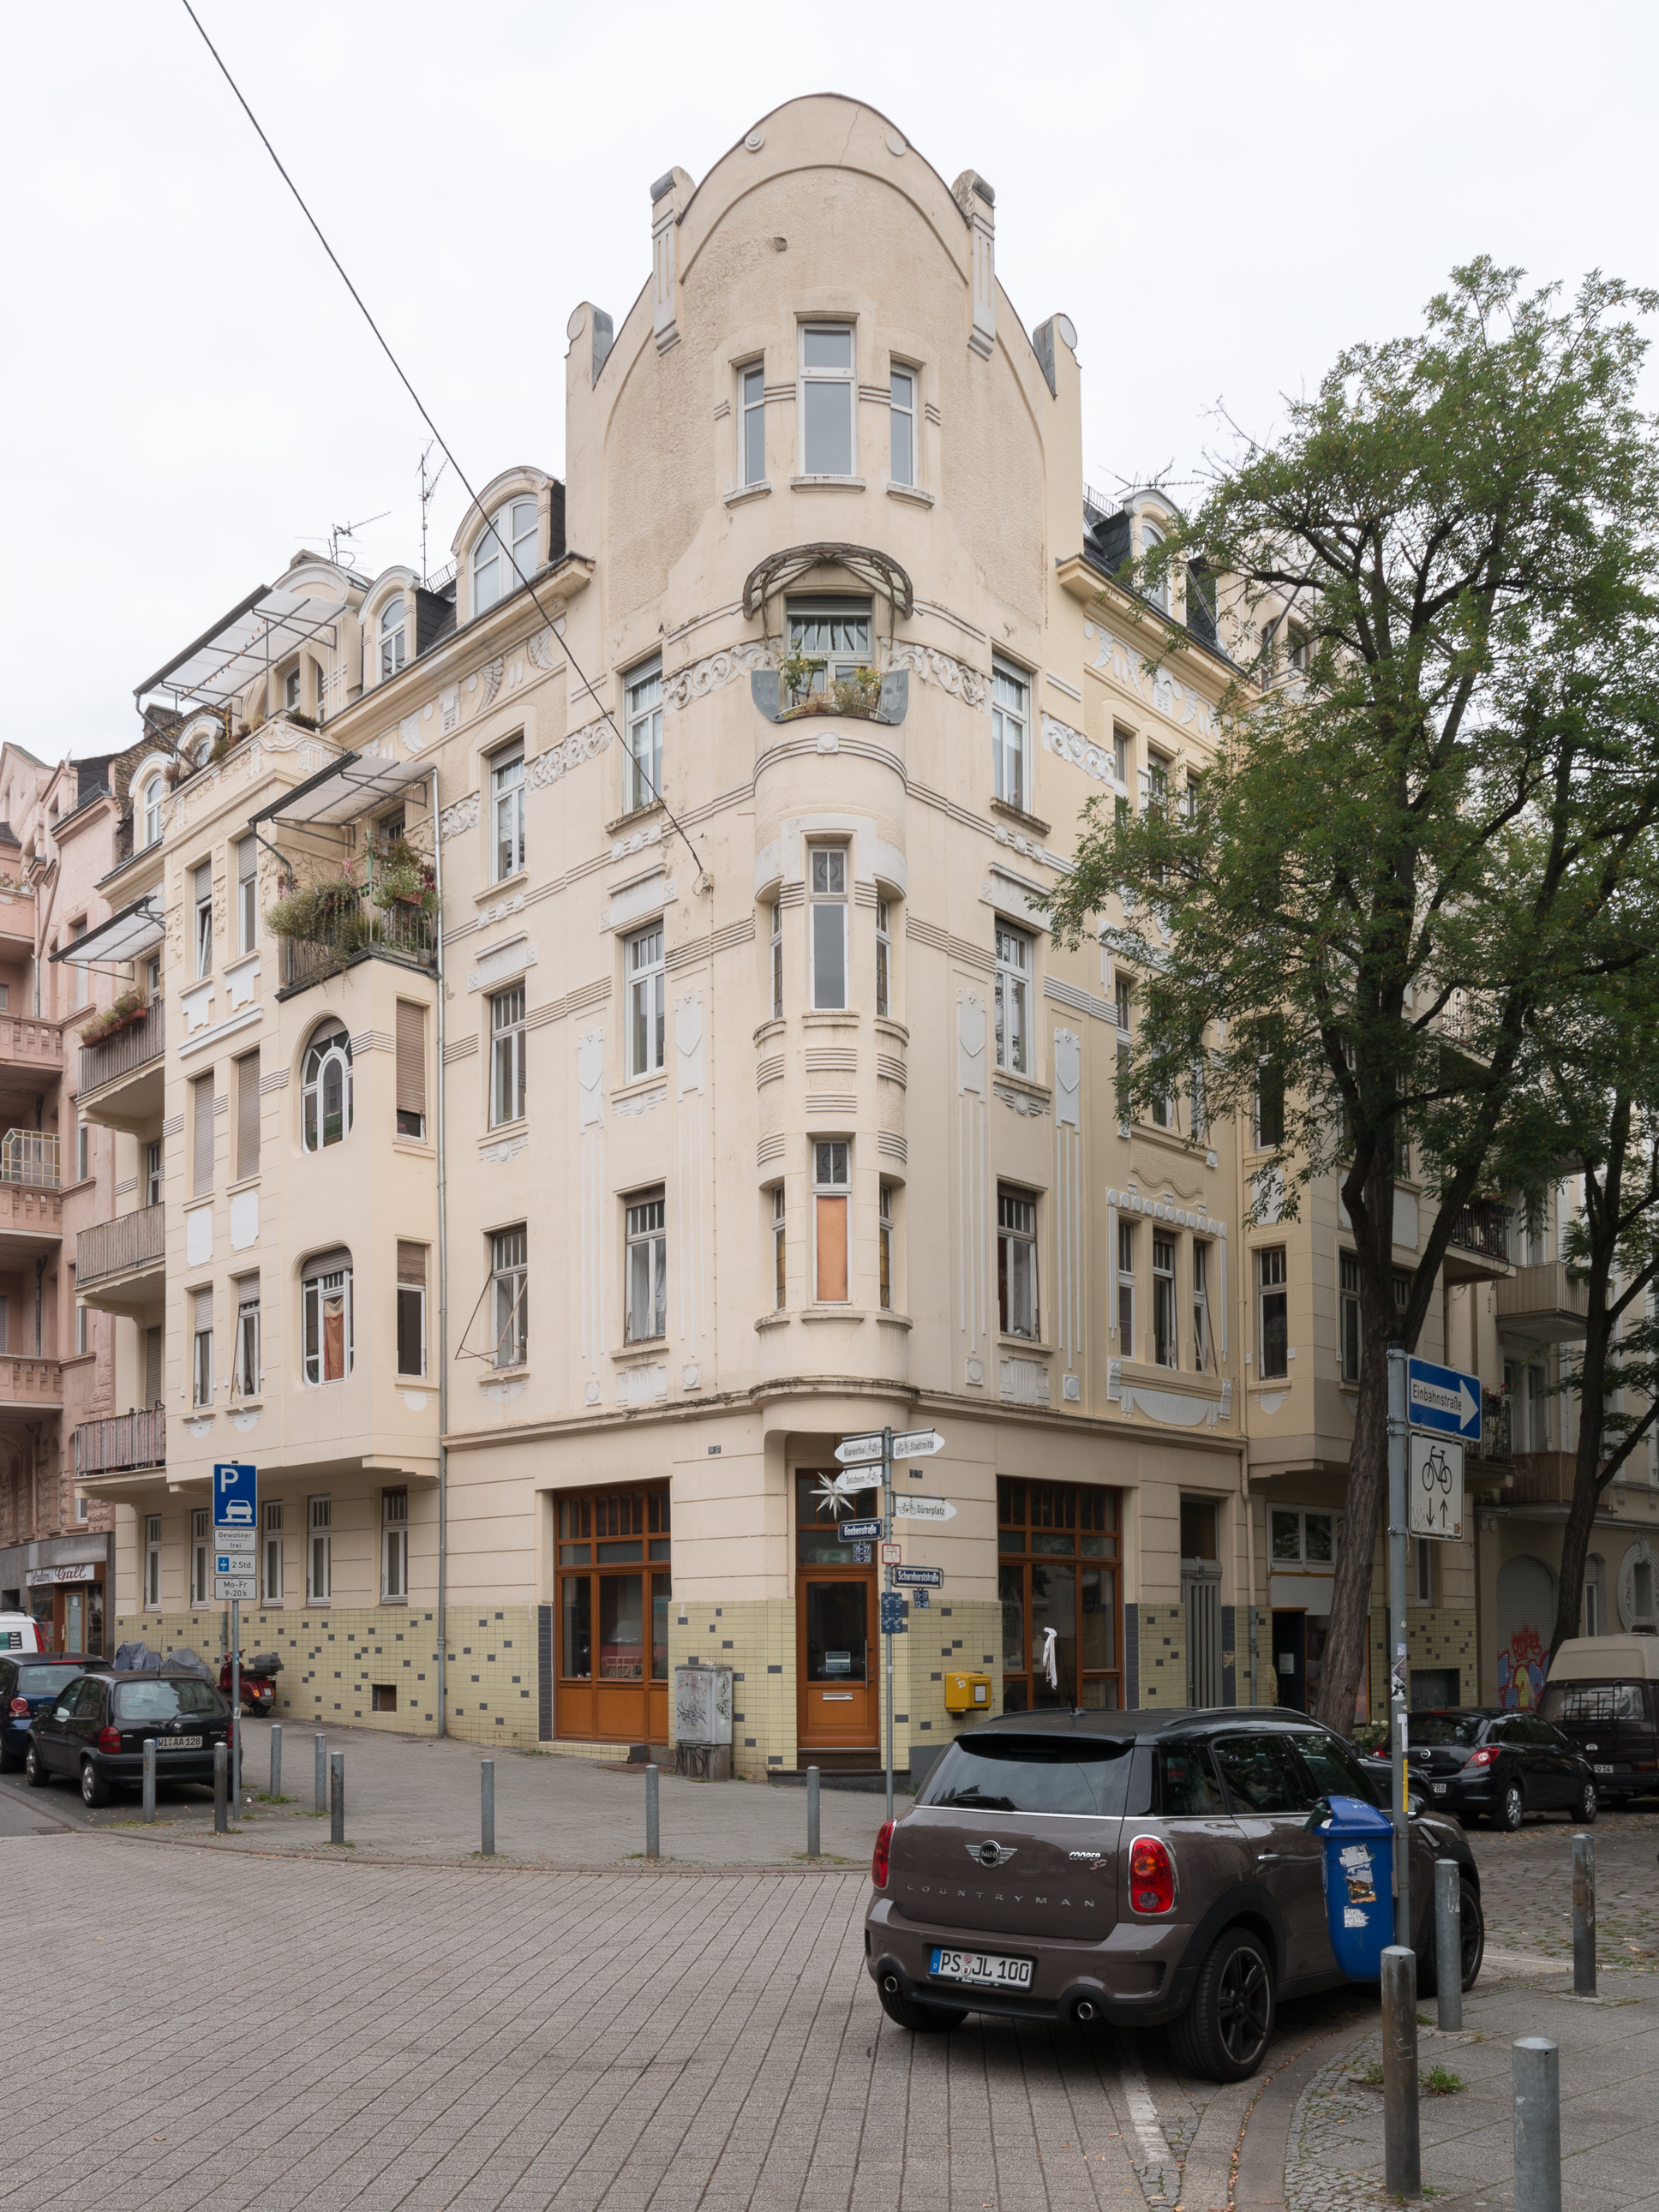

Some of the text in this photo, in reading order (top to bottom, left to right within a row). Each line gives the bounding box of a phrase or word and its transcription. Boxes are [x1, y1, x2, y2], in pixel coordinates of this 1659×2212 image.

[1413, 1384, 1462, 1411] Einbahnstraße
[844, 1445, 865, 1456] Klarenthal
[910, 1439, 934, 1451] Stadtmitte
[220, 1468, 239, 1492] P
[846, 1474, 865, 1485] Dotzheim
[917, 1504, 945, 1516] Dürerplatz
[844, 1524, 877, 1536] Goebenstraße
[854, 1554, 871, 1563] 34-20
[31, 1565, 87, 1585] Salon Gall
[897, 1570, 939, 1584] Scharnhorststraße
[158, 1737, 201, 1747] WI AA 128
[980, 1850, 998, 1859] MINI
[1069, 1851, 1101, 1862] COOPER
[907, 1884, 1095, 1908] COUNTRYMAN
[940, 1952, 1031, 1982] PS JL 100
